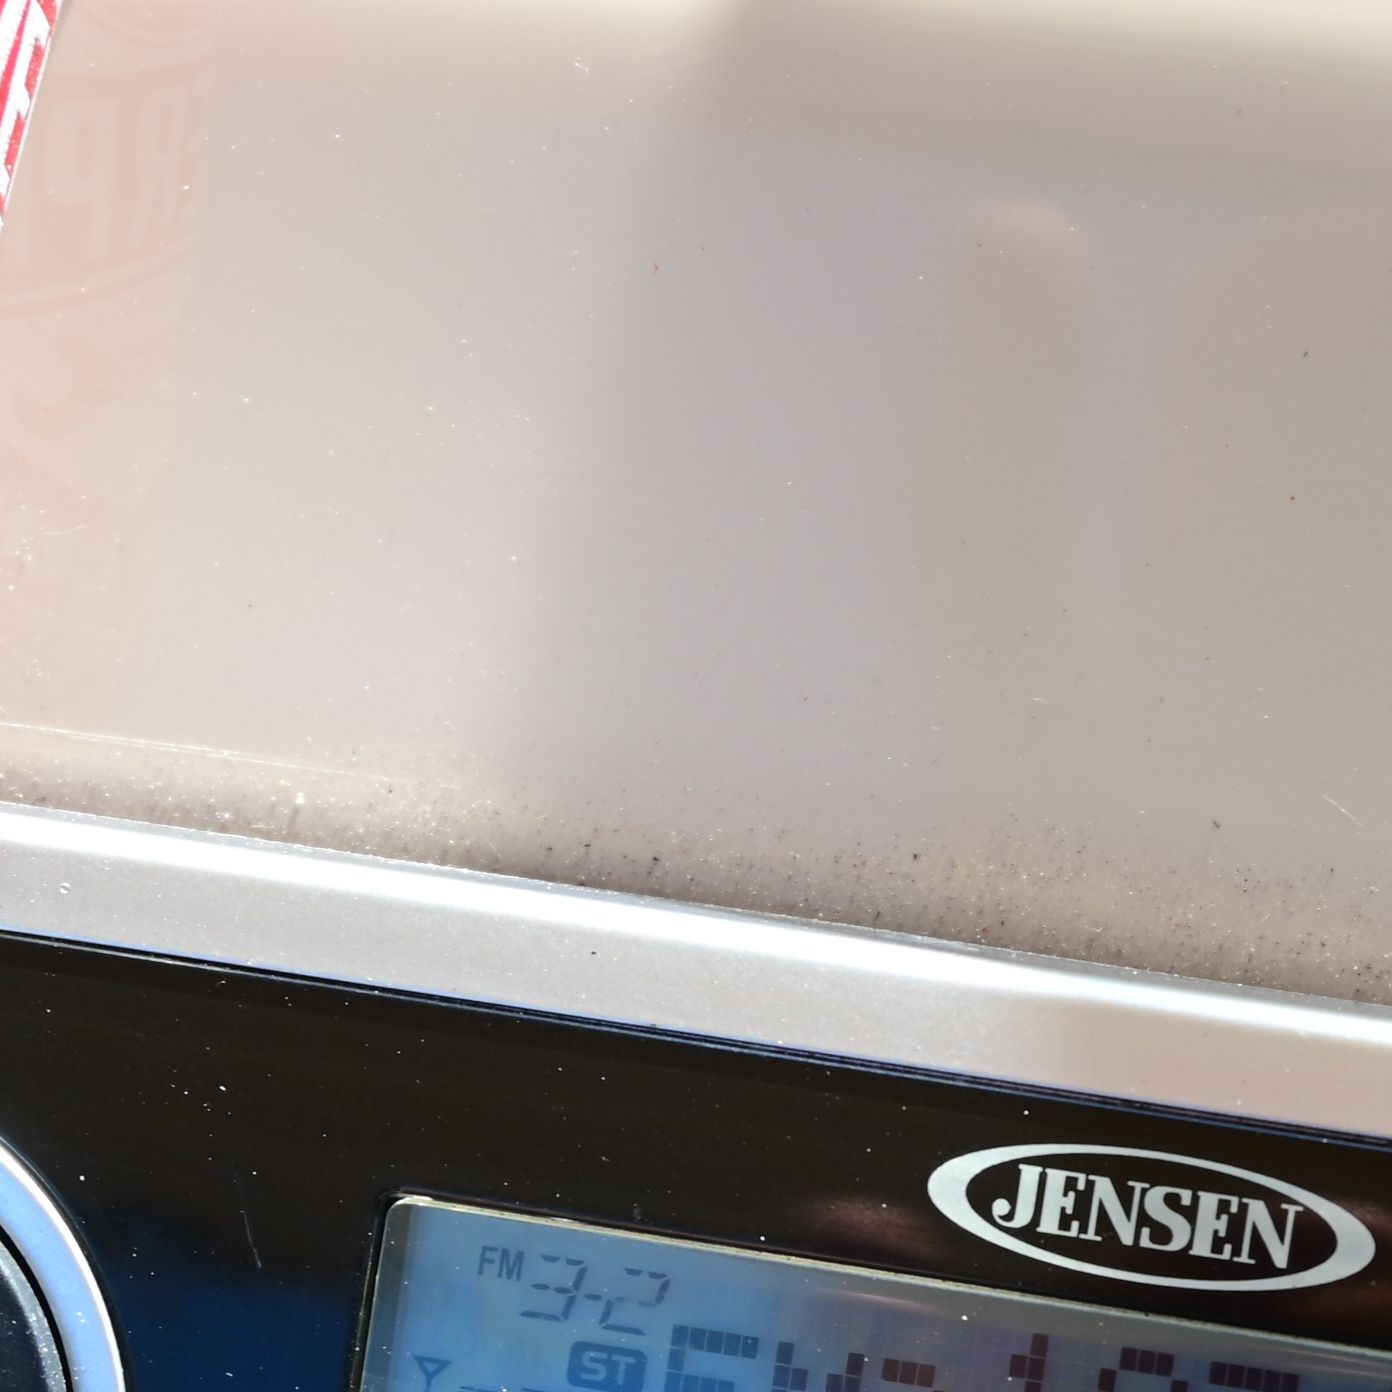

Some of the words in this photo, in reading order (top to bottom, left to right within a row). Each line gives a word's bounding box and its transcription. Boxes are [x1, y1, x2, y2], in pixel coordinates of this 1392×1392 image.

[990, 1163, 1304, 1271] JENSEN
[477, 1244, 525, 1282] FM
[579, 1349, 637, 1386] ST
